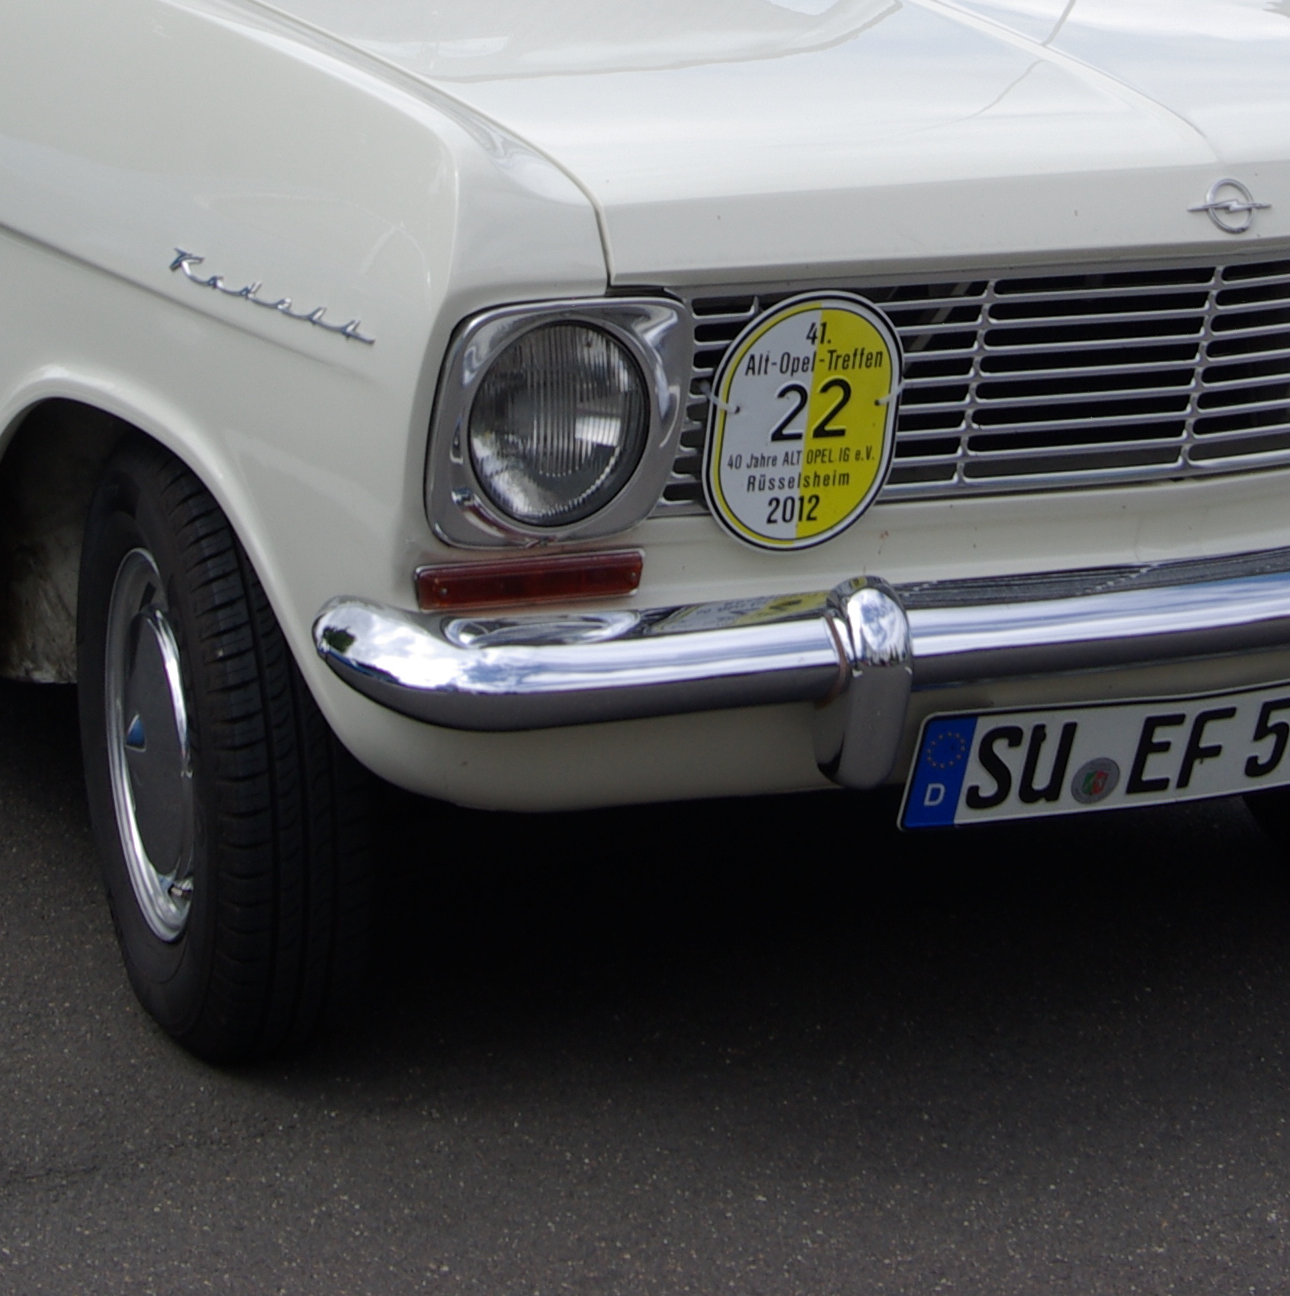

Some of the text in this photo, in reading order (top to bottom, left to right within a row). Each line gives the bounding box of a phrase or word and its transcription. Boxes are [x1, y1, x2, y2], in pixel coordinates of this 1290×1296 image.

[805, 321, 832, 346] 41.
[745, 349, 883, 377] Alt-Opel-Treffen
[770, 377, 852, 443] 22
[727, 445, 875, 471] 40 Jahre ALT OPEL IG e.V.
[746, 469, 851, 492] Rüsselsheim
[766, 494, 820, 524] 2012
[965, 721, 1078, 810] SU
[1125, 706, 1238, 796] EF
[923, 783, 946, 808] D
